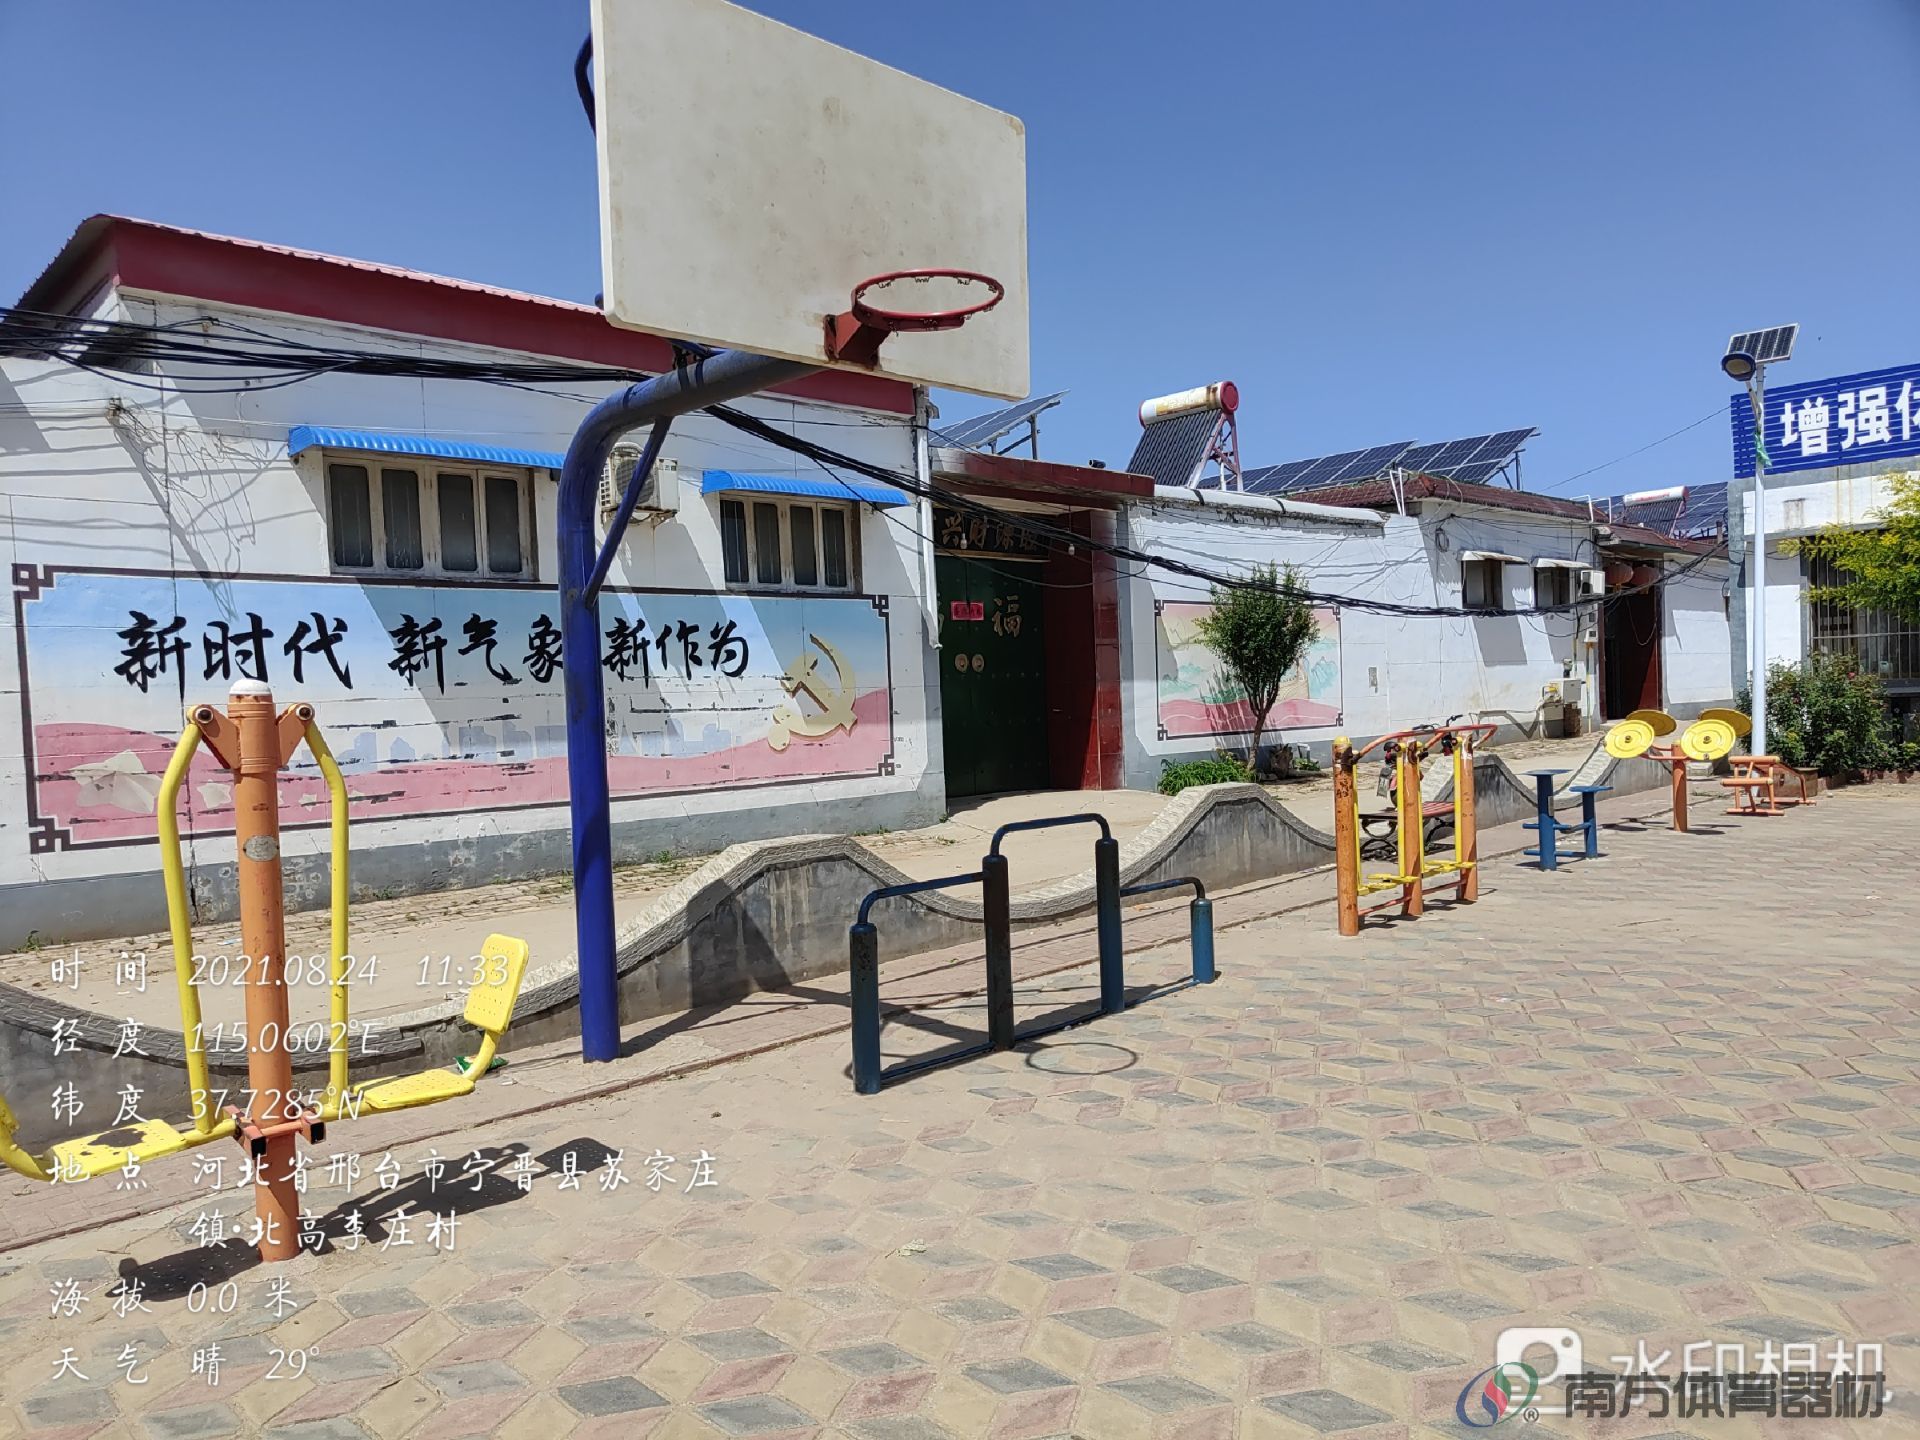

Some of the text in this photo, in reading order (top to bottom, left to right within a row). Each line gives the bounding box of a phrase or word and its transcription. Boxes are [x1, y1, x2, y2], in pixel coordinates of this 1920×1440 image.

[992, 595, 1022, 638] 福
[115, 609, 751, 702] 新时代 新气象 新作为
